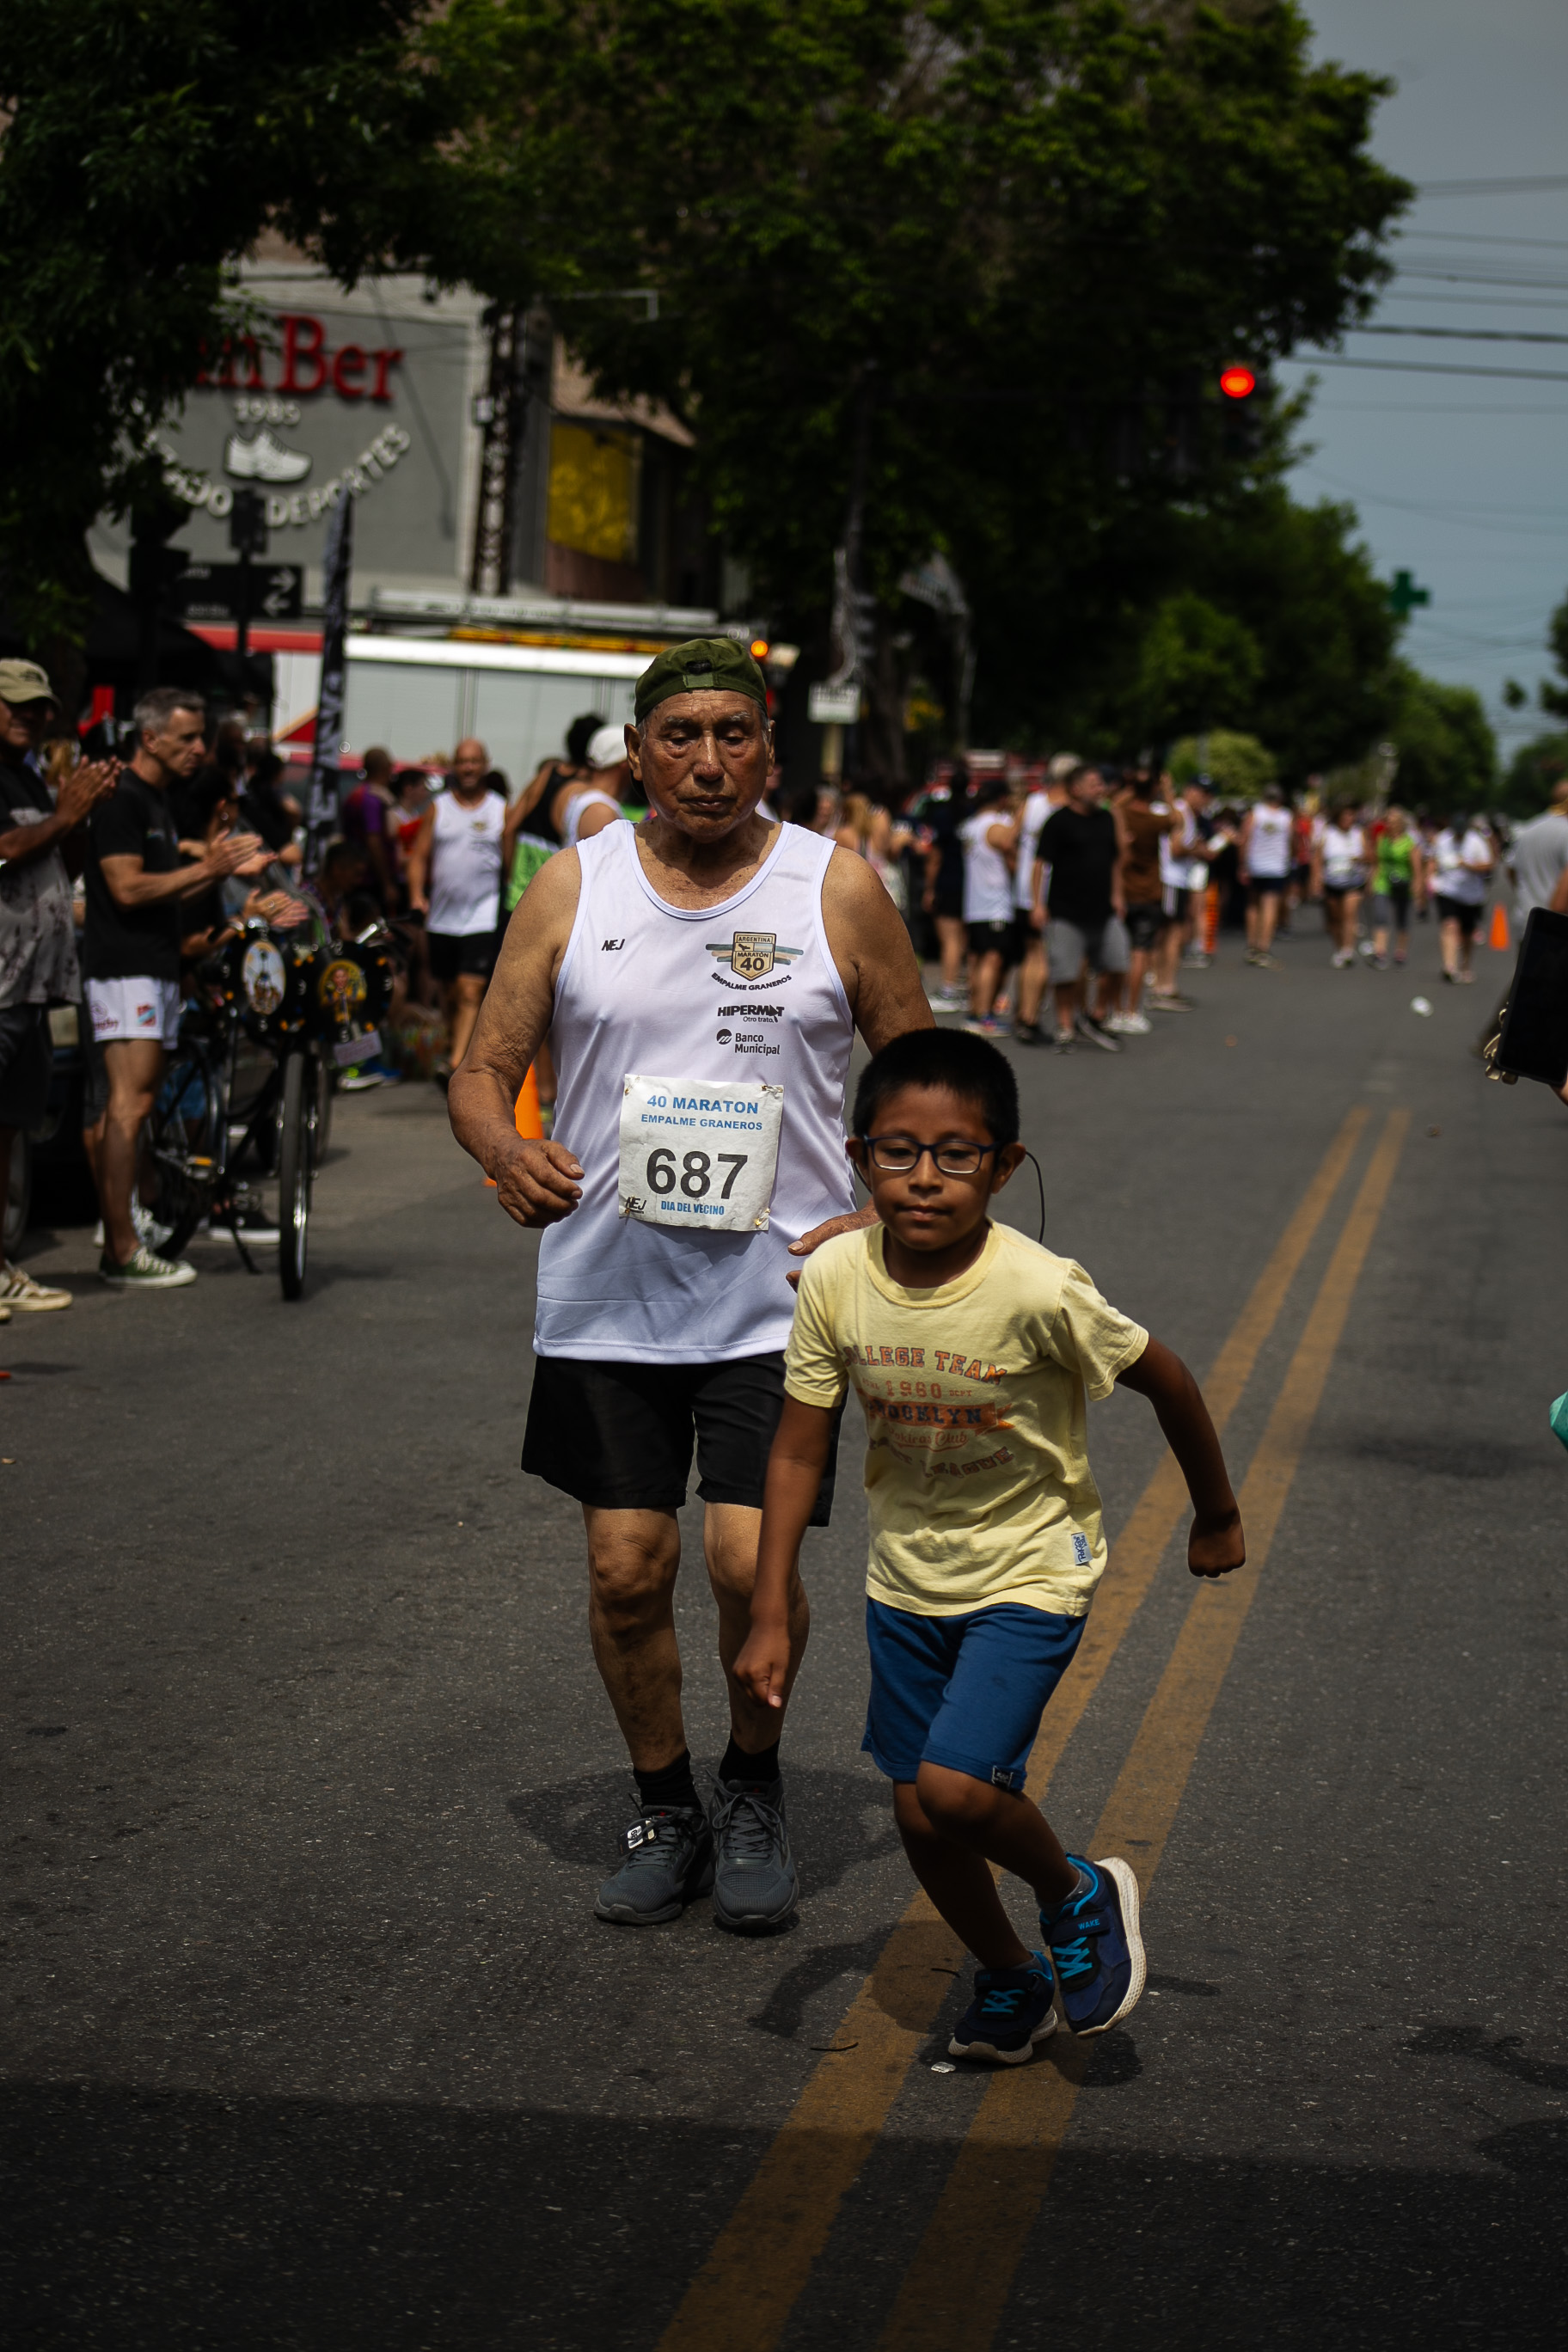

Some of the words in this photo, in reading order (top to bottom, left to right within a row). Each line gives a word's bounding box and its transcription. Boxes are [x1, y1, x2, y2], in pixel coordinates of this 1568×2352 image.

[601, 939, 625, 952] NEJ
[740, 958, 764, 971] 40
[711, 972, 747, 990] EMPALME
[748, 975, 792, 990] GRANEROS
[735, 1032, 763, 1043] Banco
[734, 1043, 780, 1056] Municipal
[646, 1094, 666, 1108] 40
[672, 1097, 758, 1114] MARATON
[640, 1114, 696, 1126] EMPALME
[699, 1118, 763, 1130] GRANEROS
[646, 1148, 748, 1200] 687
[660, 1200, 677, 1212] DIA
[677, 1201, 692, 1214] DEL
[693, 1204, 725, 1216] VECINO
[841, 1344, 924, 1368] OLLEGE
[935, 1351, 1007, 1385] TEAM
[1077, 1918, 1100, 1930] WAKE
